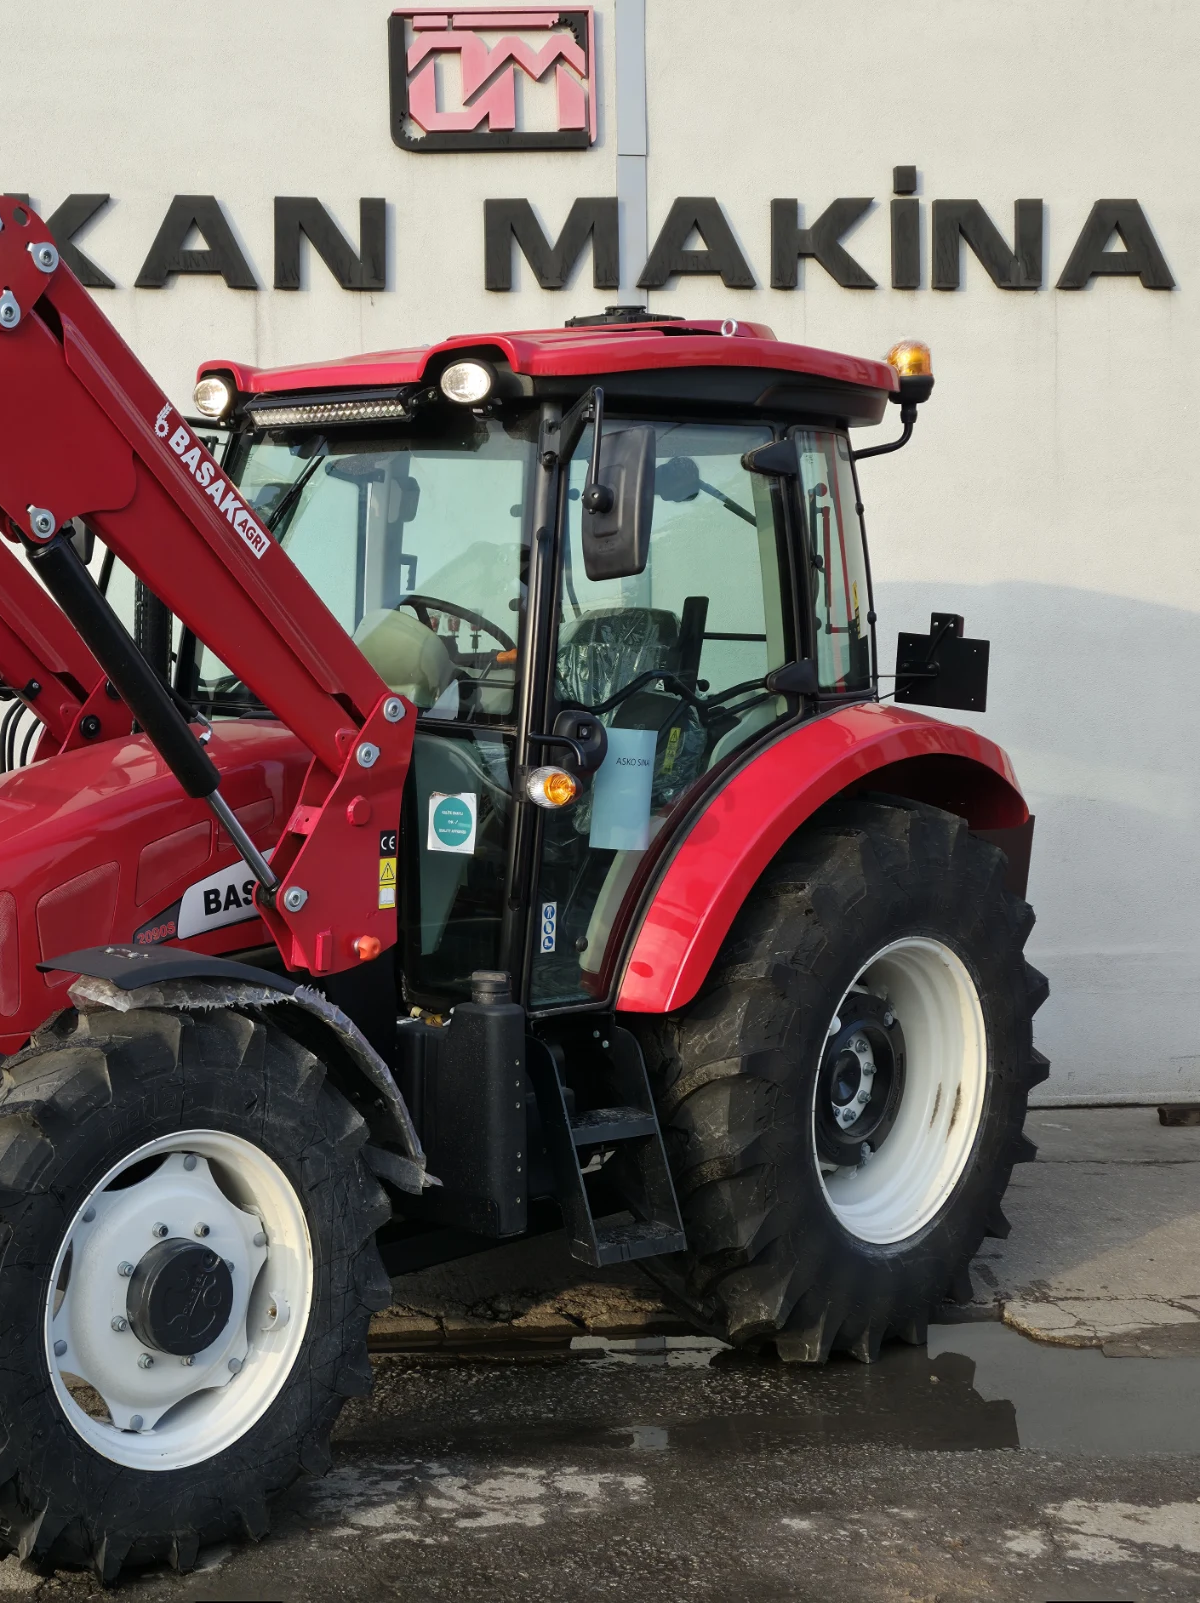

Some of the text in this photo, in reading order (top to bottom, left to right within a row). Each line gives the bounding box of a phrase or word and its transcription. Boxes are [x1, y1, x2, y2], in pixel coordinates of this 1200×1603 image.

[484, 165, 1176, 291] MAKİNA
[168, 425, 266, 553] BASAK AGRI
[380, 835, 396, 851] CE
[136, 921, 177, 945] 2090S
